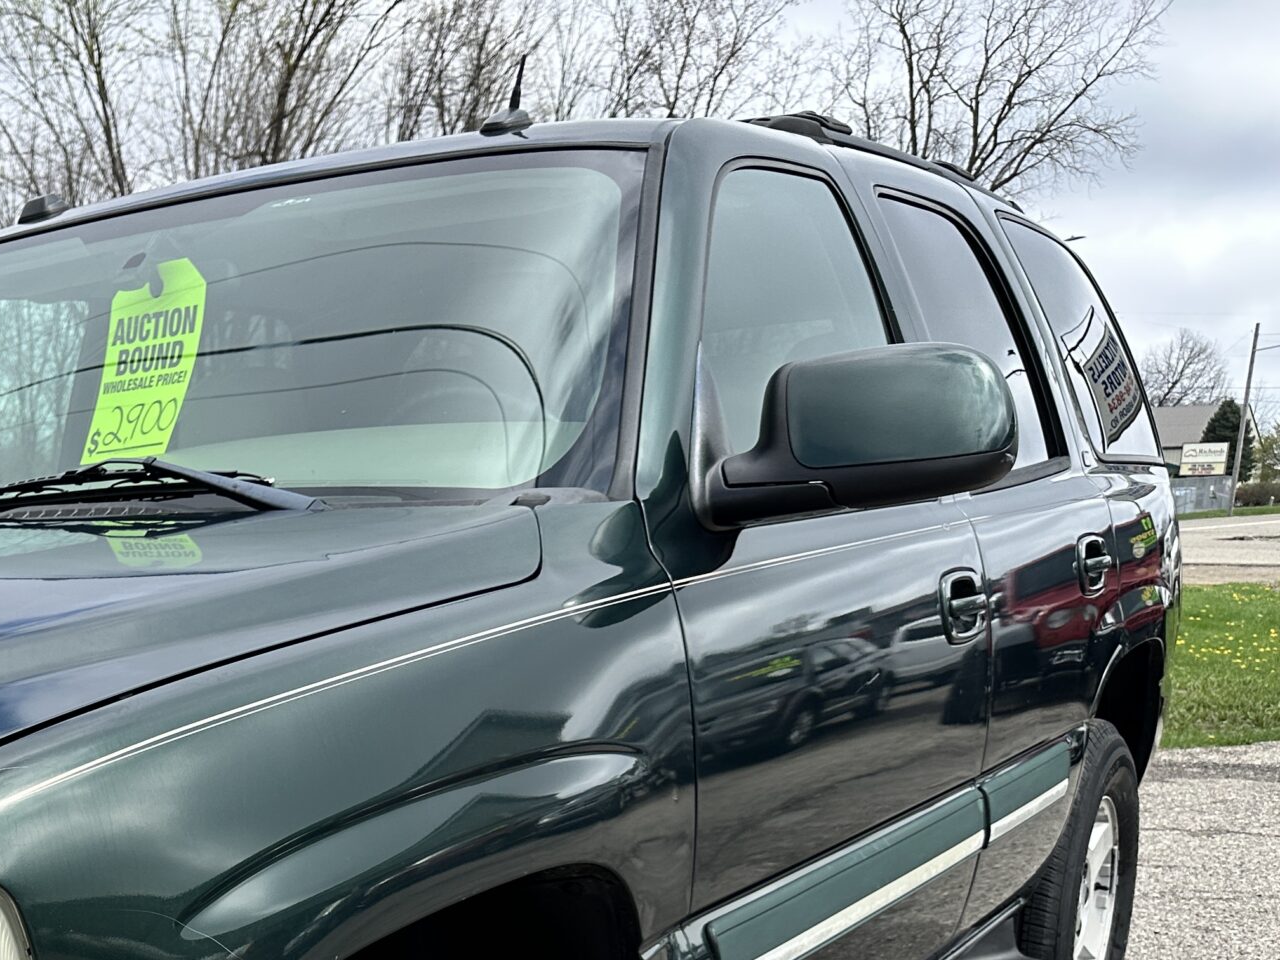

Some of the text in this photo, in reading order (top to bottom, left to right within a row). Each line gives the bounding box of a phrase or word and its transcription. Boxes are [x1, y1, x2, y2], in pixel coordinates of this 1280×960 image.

[111, 305, 198, 346] AUCTION
[115, 340, 185, 377] BOUND
[102, 370, 187, 395] WHOLESALE PRICE!
